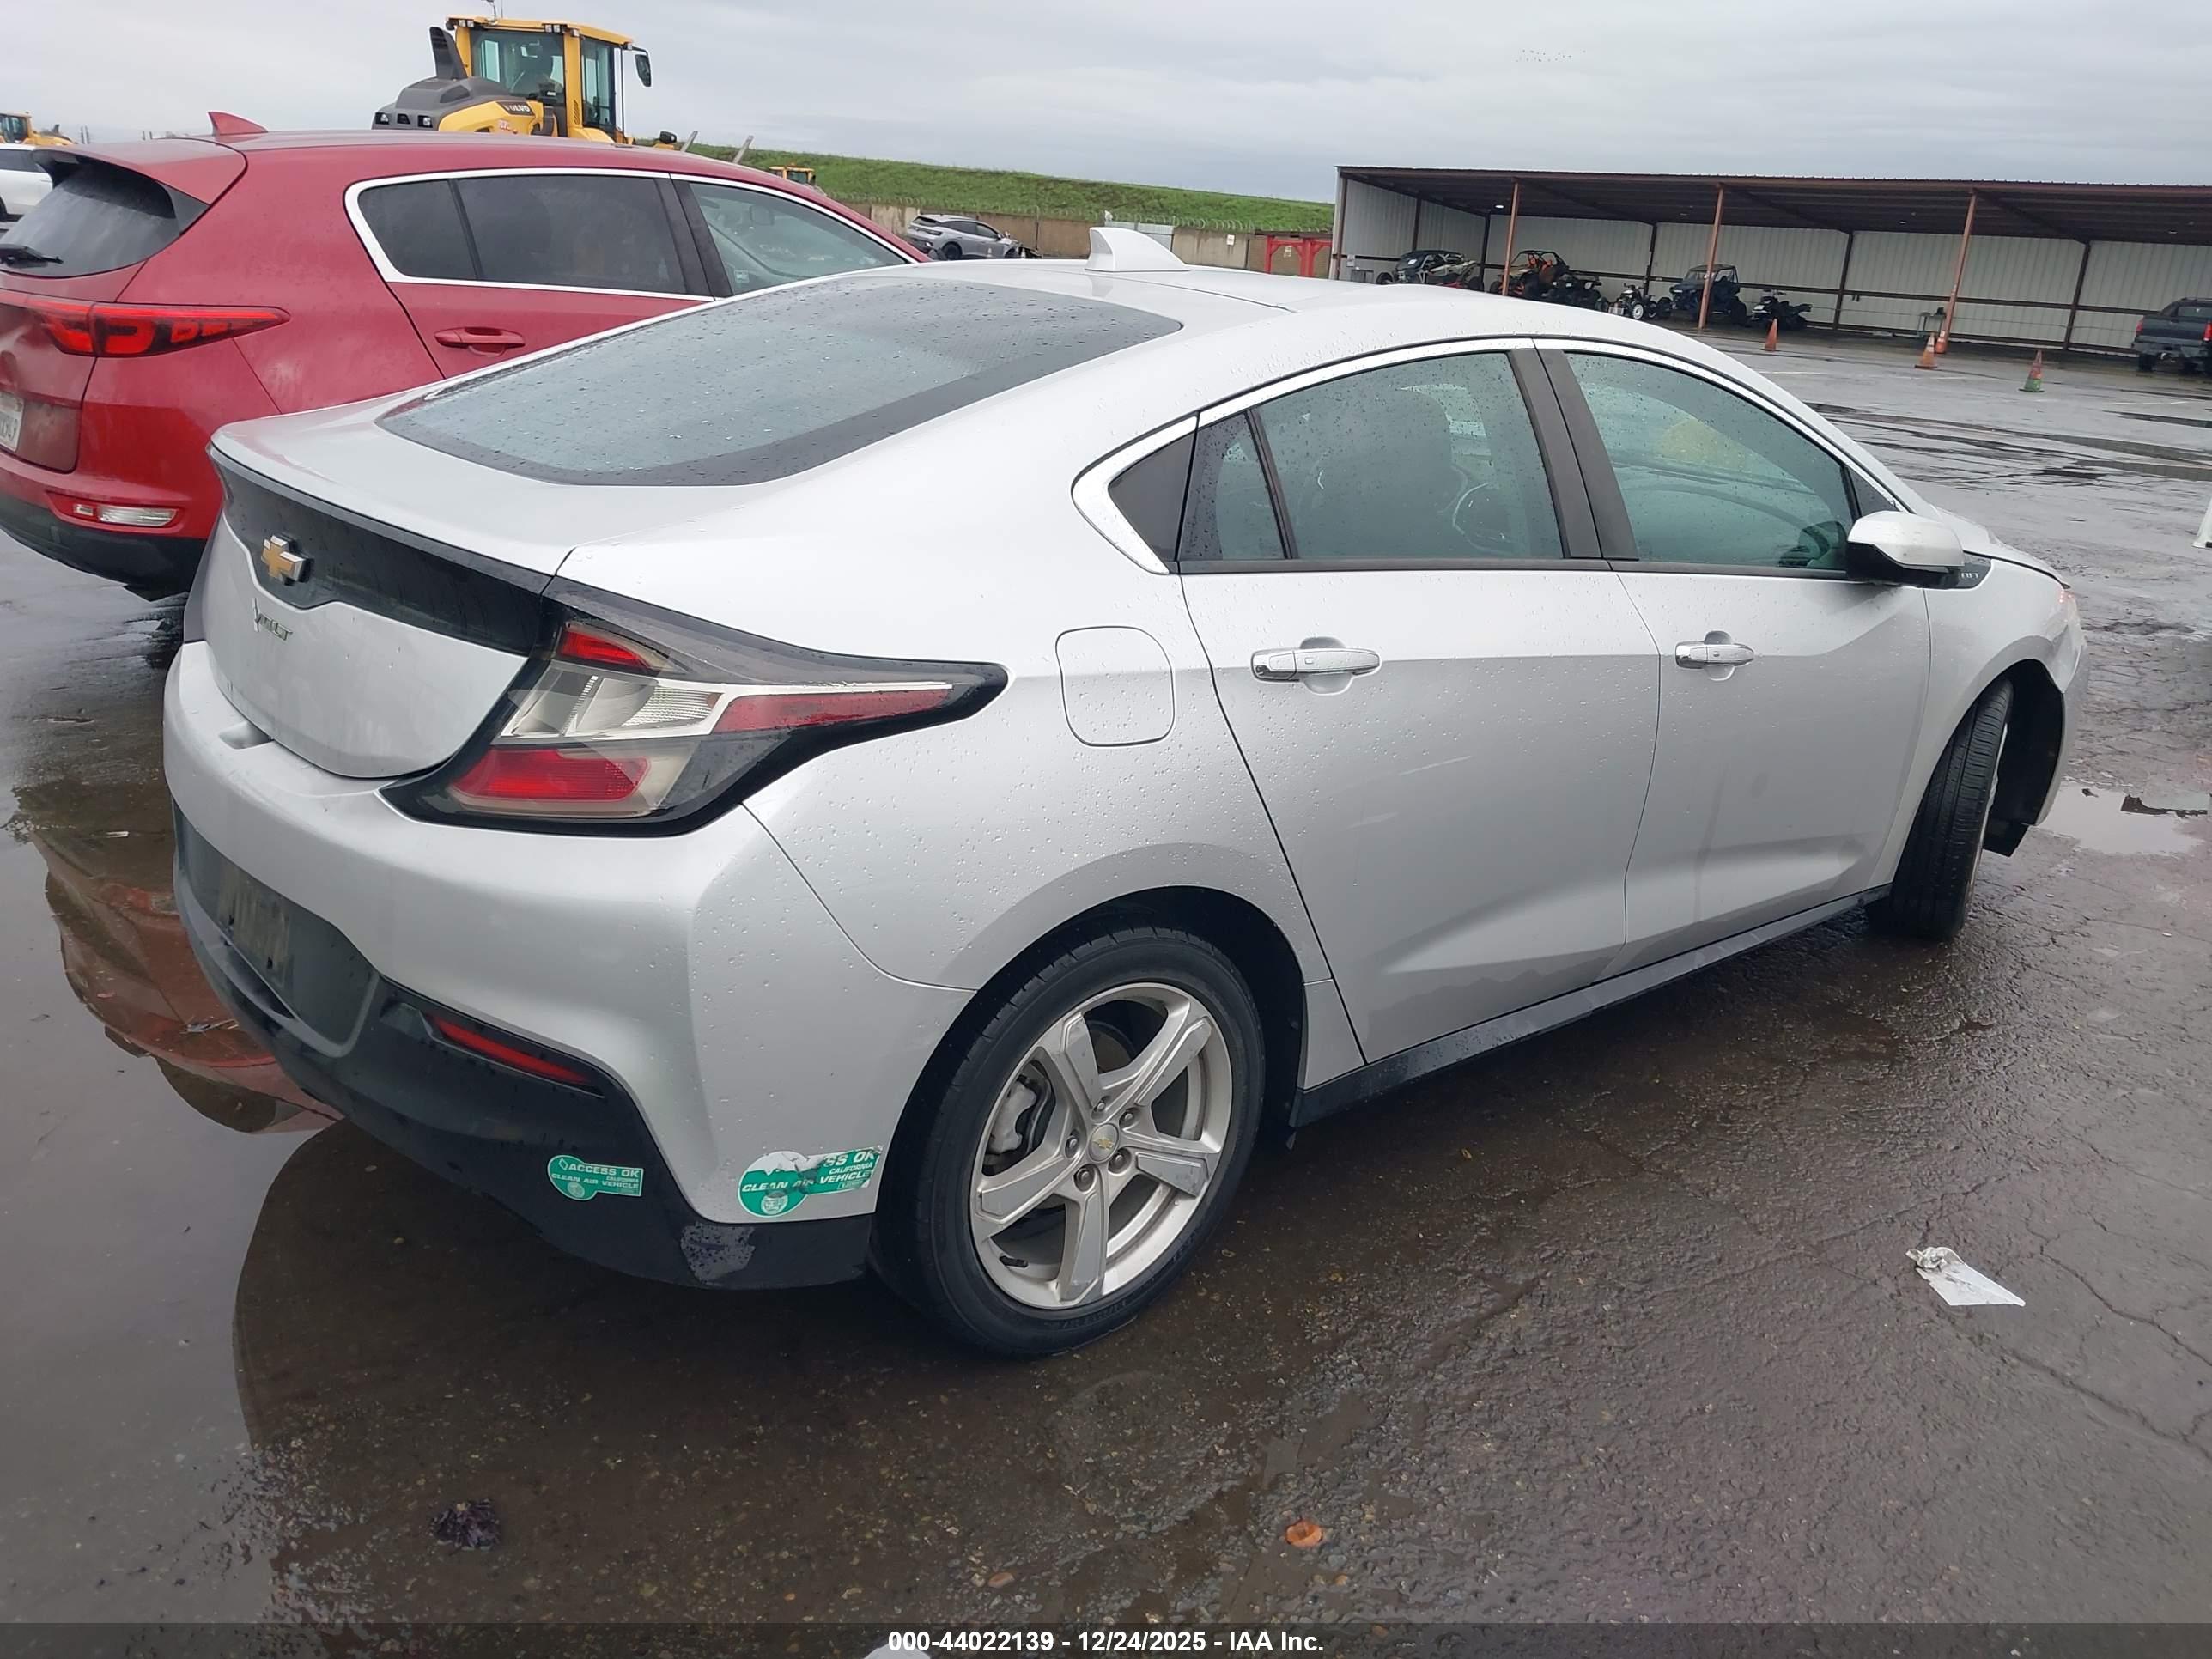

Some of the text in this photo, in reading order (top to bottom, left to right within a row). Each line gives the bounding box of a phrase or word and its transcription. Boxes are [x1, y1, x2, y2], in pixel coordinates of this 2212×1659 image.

[568, 1163, 640, 1178] ACCESS OK
[829, 1162, 873, 1176] CALIFORNIA
[550, 1172, 580, 1182] CLEAN
[601, 1180, 640, 1189] VEHICLE
[741, 1181, 789, 1192] CLEAN
[819, 1170, 870, 1184] VEHICLE
